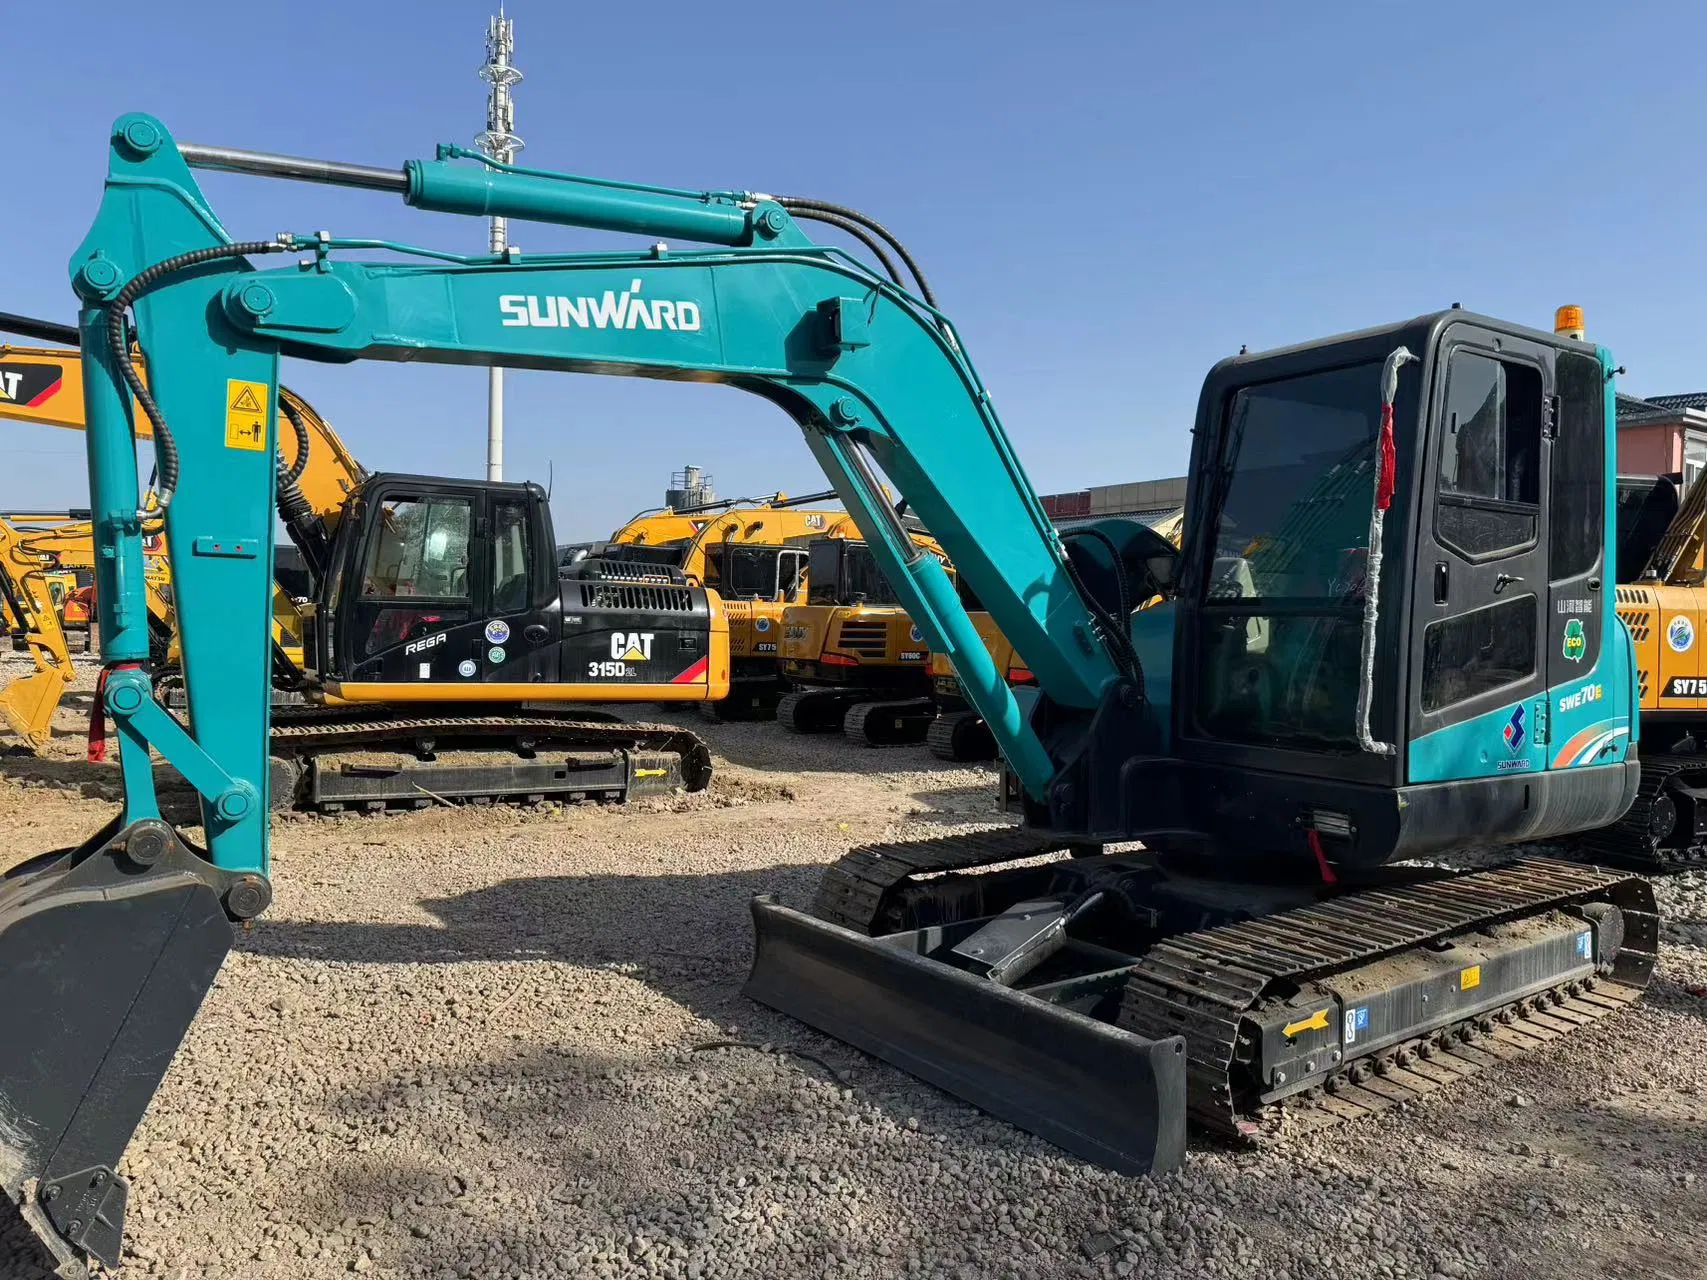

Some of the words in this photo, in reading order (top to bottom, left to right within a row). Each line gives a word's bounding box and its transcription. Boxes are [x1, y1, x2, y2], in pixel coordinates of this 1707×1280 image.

[499, 278, 700, 331] SUNWARD
[805, 514, 821, 527] CAT
[1557, 598, 1593, 614] 山河智能
[405, 633, 447, 655] REGA
[611, 632, 654, 660] CAT
[758, 643, 777, 651] SY75
[1567, 637, 1582, 648] ECO
[1673, 679, 1707, 695] SY75
[1559, 683, 1602, 713] SWE70E
[1497, 758, 1530, 771] SUNWARD
